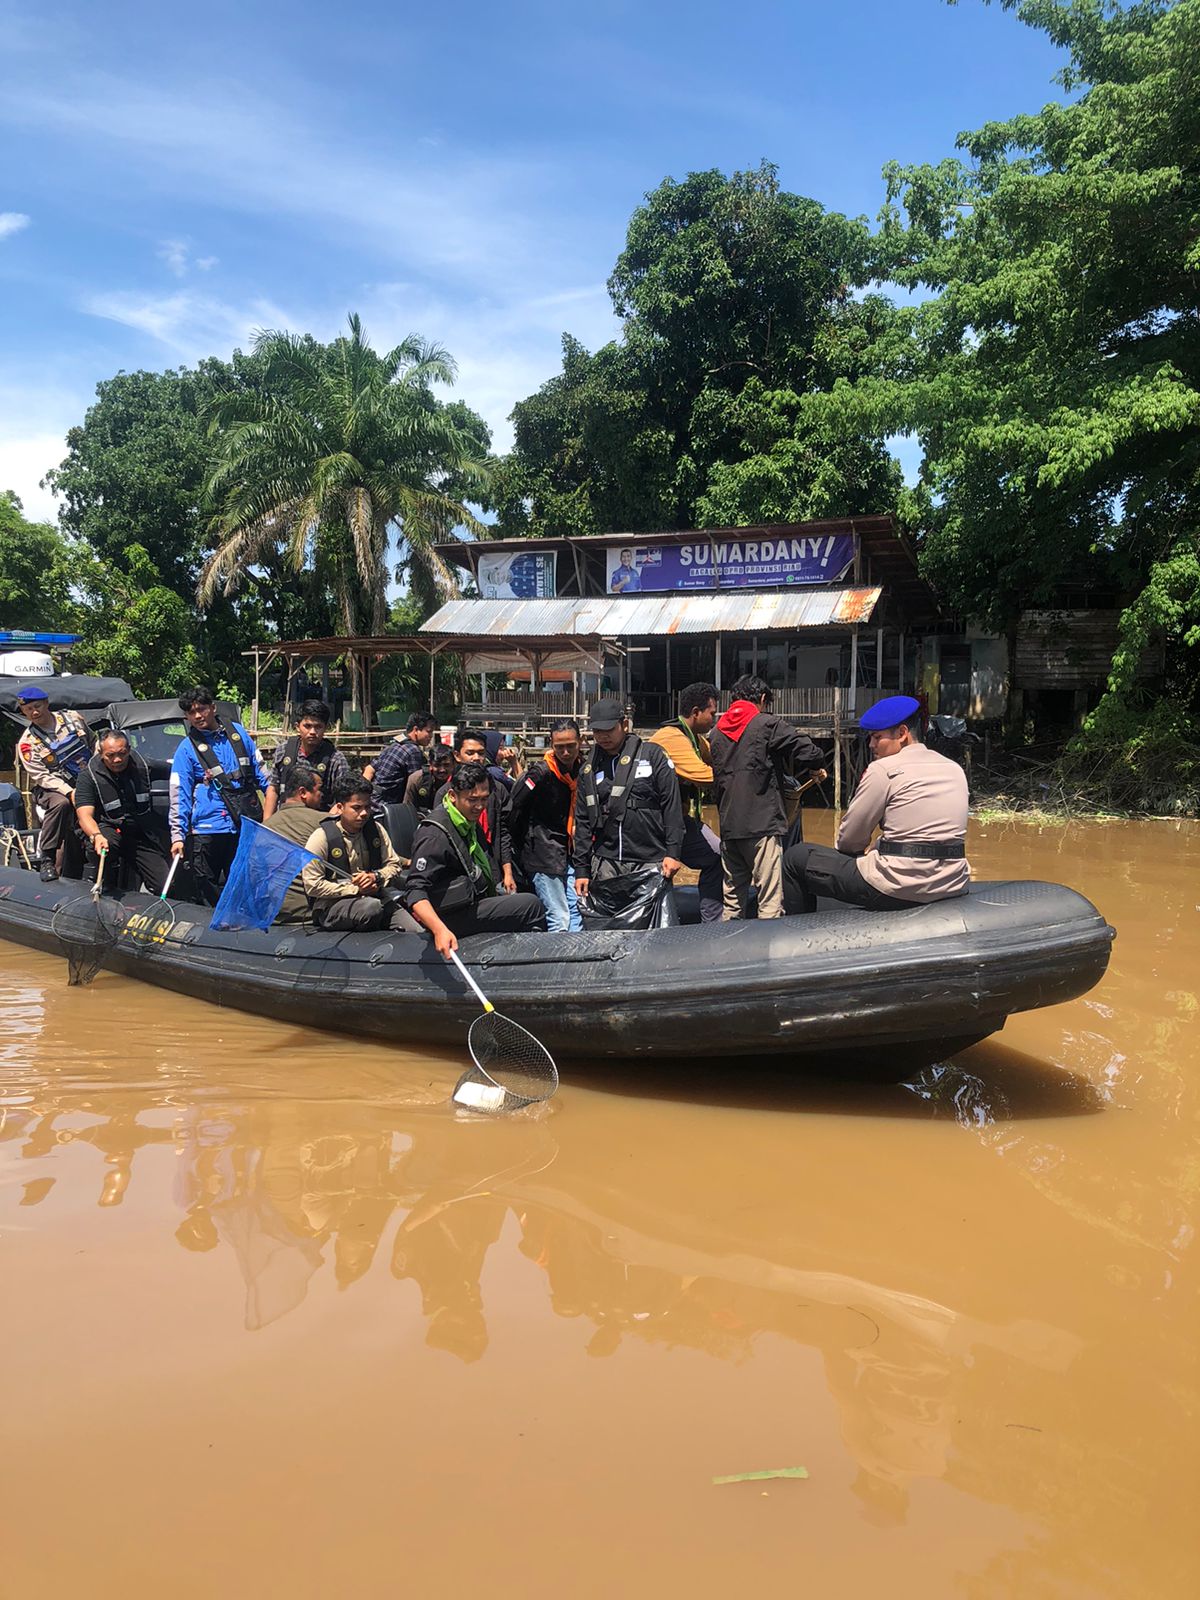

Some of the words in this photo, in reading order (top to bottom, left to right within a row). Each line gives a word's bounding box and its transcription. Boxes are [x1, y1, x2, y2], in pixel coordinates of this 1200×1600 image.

[680, 535, 836, 567] SUMARDANY!
[745, 564, 782, 574] PROVINSI
[783, 562, 802, 572] RIAU
[14, 665, 51, 673] GARMIN
